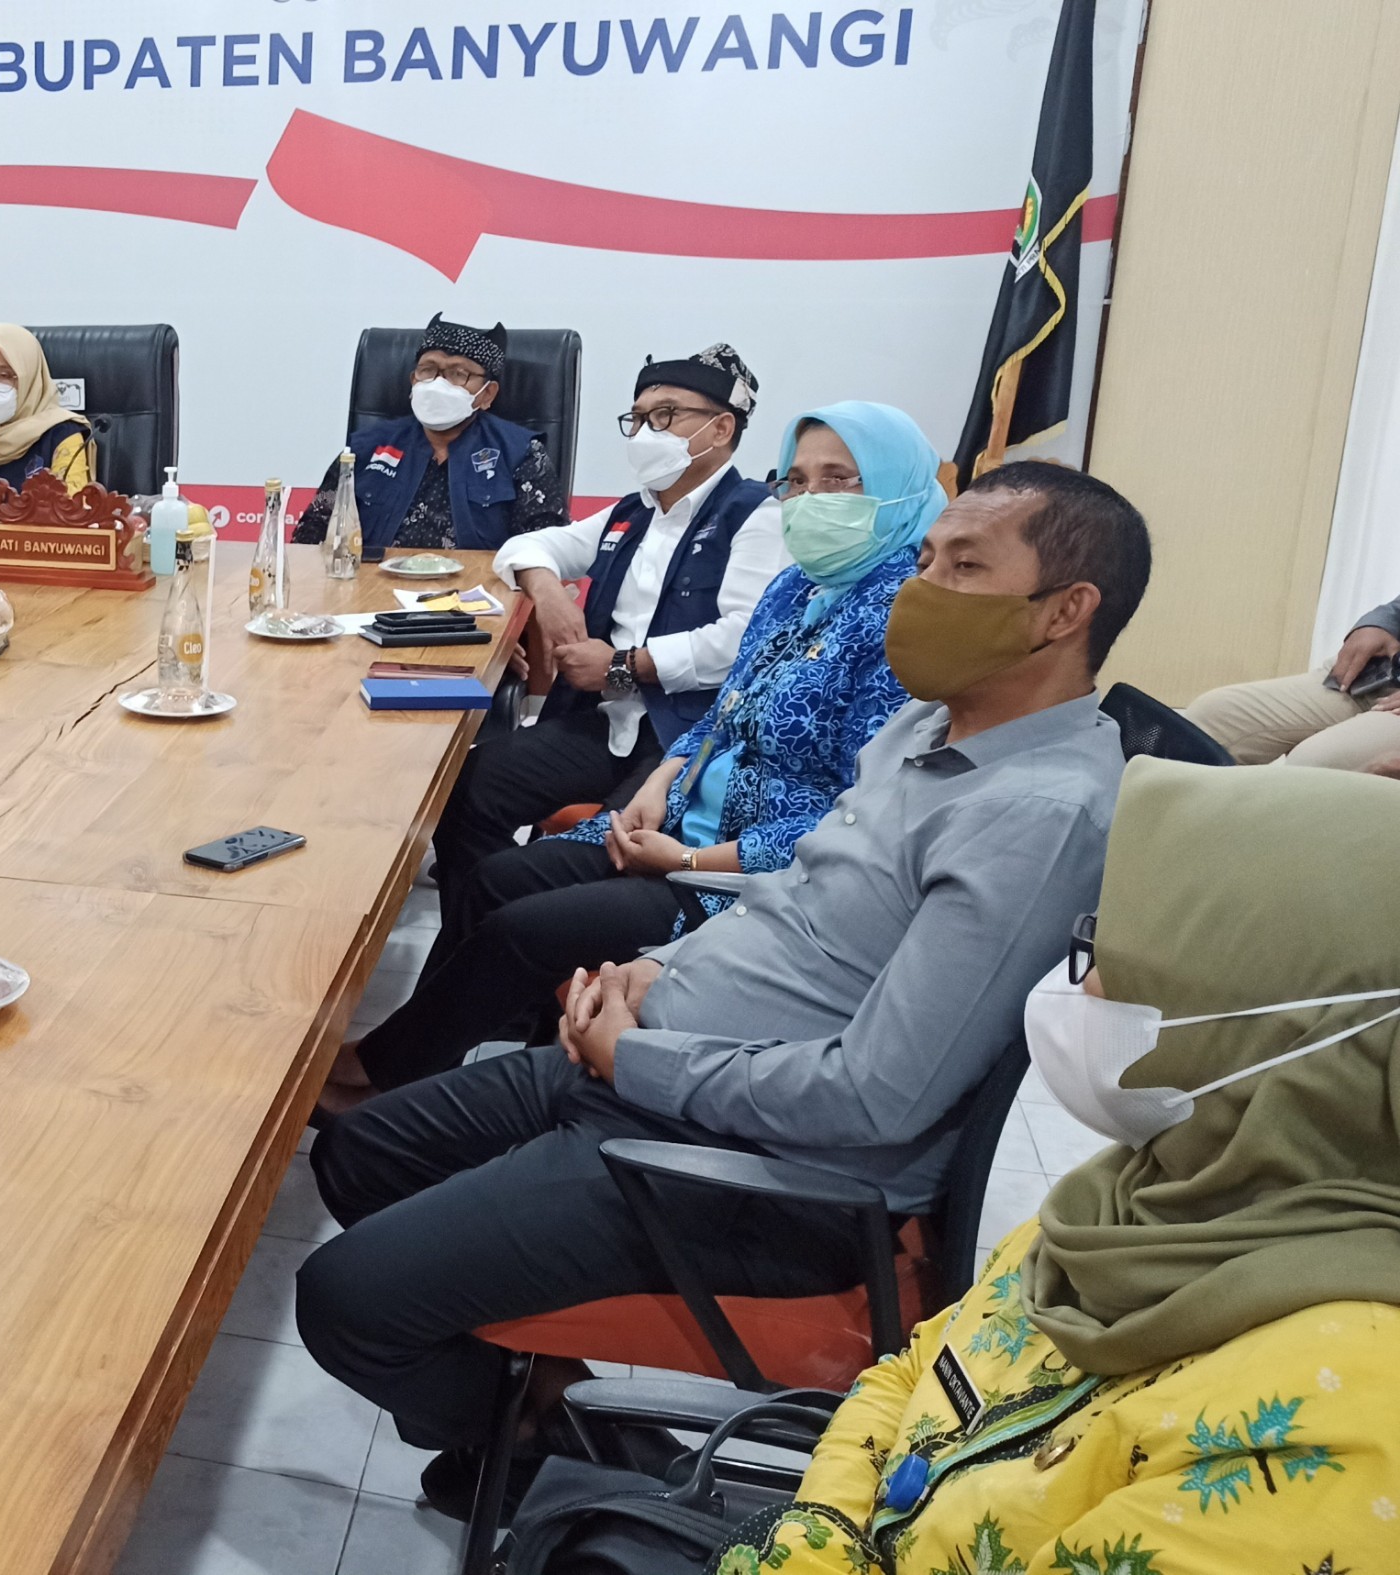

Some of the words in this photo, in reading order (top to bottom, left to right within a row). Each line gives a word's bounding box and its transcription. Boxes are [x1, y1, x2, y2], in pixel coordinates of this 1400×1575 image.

[344, 9, 914, 83] BANYUWANGI
[24, 540, 105, 556] BANYUWANGI
[183, 642, 202, 655] Cleo
